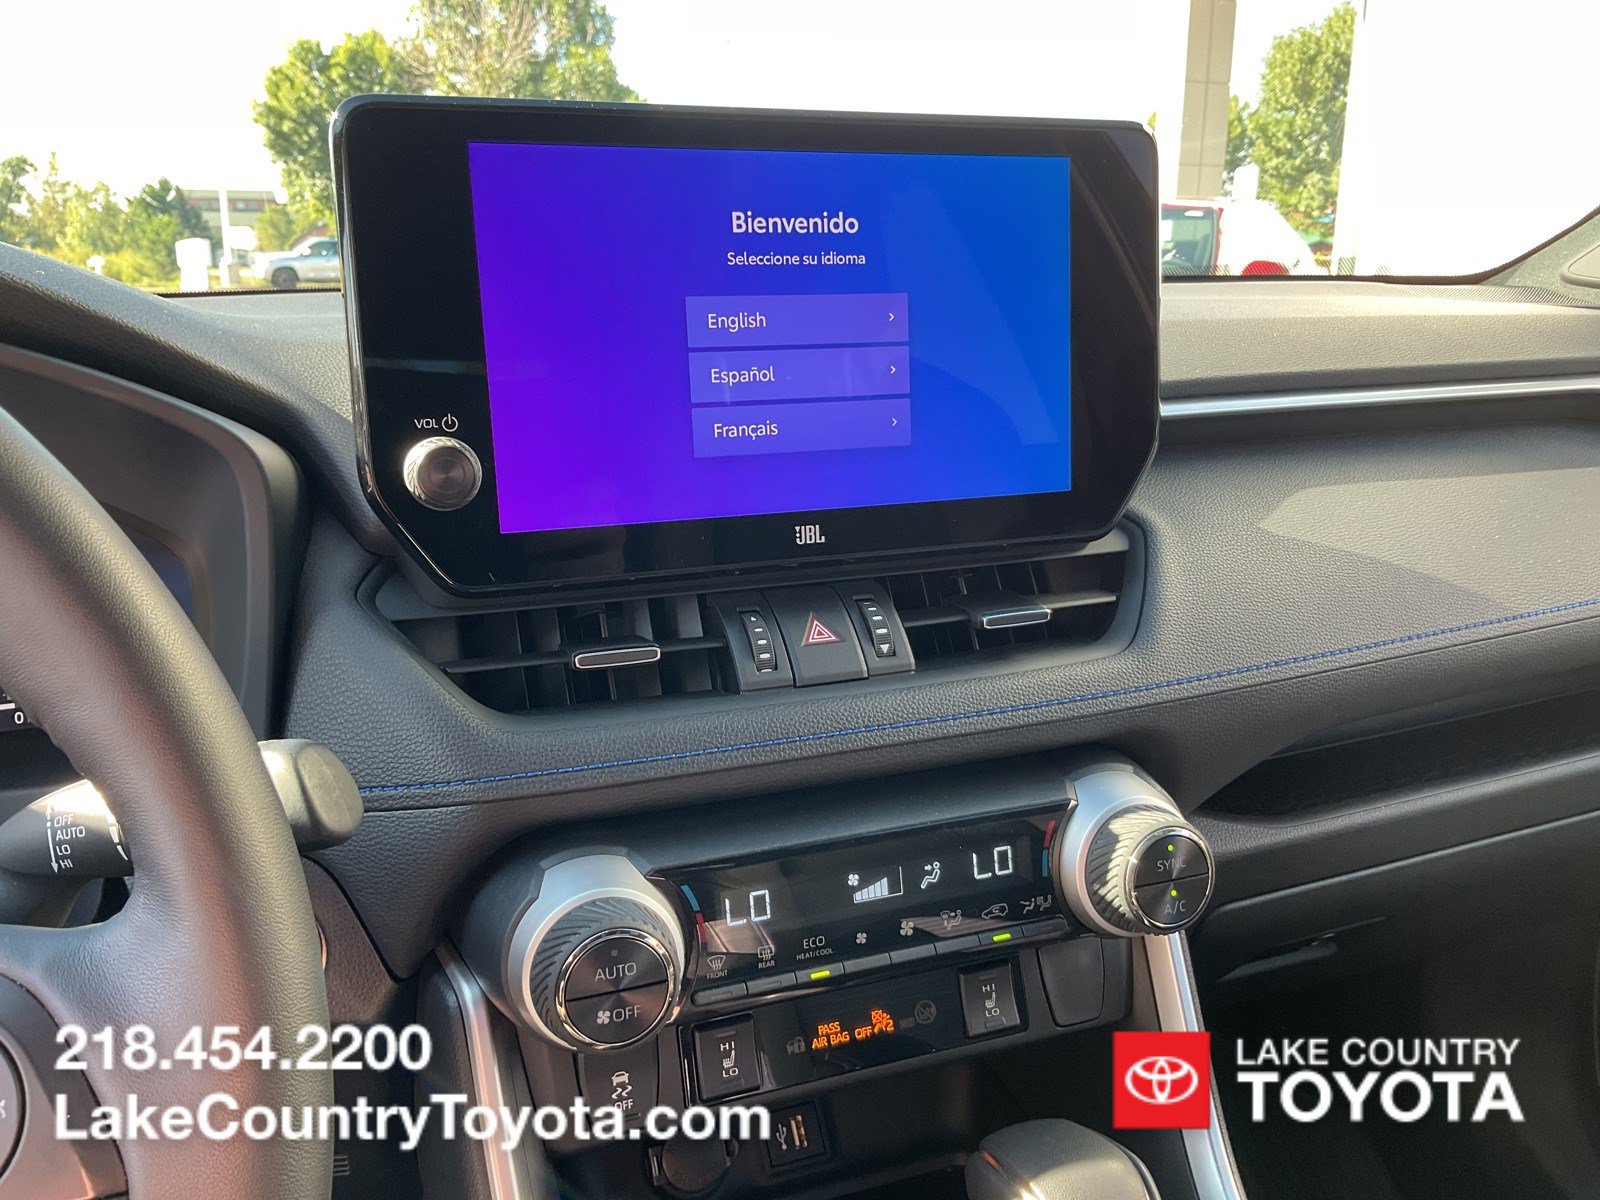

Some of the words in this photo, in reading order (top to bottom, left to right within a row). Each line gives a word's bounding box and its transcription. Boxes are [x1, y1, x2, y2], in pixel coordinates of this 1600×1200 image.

[731, 210, 859, 234] Bienvenido
[727, 251, 800, 266] Seleccione
[802, 255, 818, 265] su
[821, 251, 866, 265] idioma
[707, 312, 767, 332] English
[710, 366, 775, 386] Español
[414, 418, 439, 429] VOL
[713, 420, 779, 440] Français
[795, 524, 825, 545] JBL
[53, 814, 74, 828] OFF
[55, 825, 86, 841] AUTO
[56, 844, 71, 856] LO
[59, 859, 74, 869] HI
[971, 845, 1014, 880] LO
[1156, 855, 1188, 873] SYNC
[724, 889, 772, 927] LO
[1163, 899, 1187, 915] A/C
[802, 935, 826, 949] ECO
[796, 948, 833, 960] HEAT/COOL
[594, 961, 638, 982] AUTO
[757, 959, 776, 969] REAR
[706, 968, 729, 980] FRONT
[982, 983, 996, 994] HI
[612, 1004, 642, 1022] OFF
[985, 1007, 1001, 1018] LO
[818, 1021, 841, 1036] PASS
[811, 1037, 828, 1049] AIR
[829, 1031, 850, 1046] BAG
[854, 1025, 872, 1040] OFF
[720, 1041, 736, 1052] HI
[722, 1067, 740, 1078] LO
